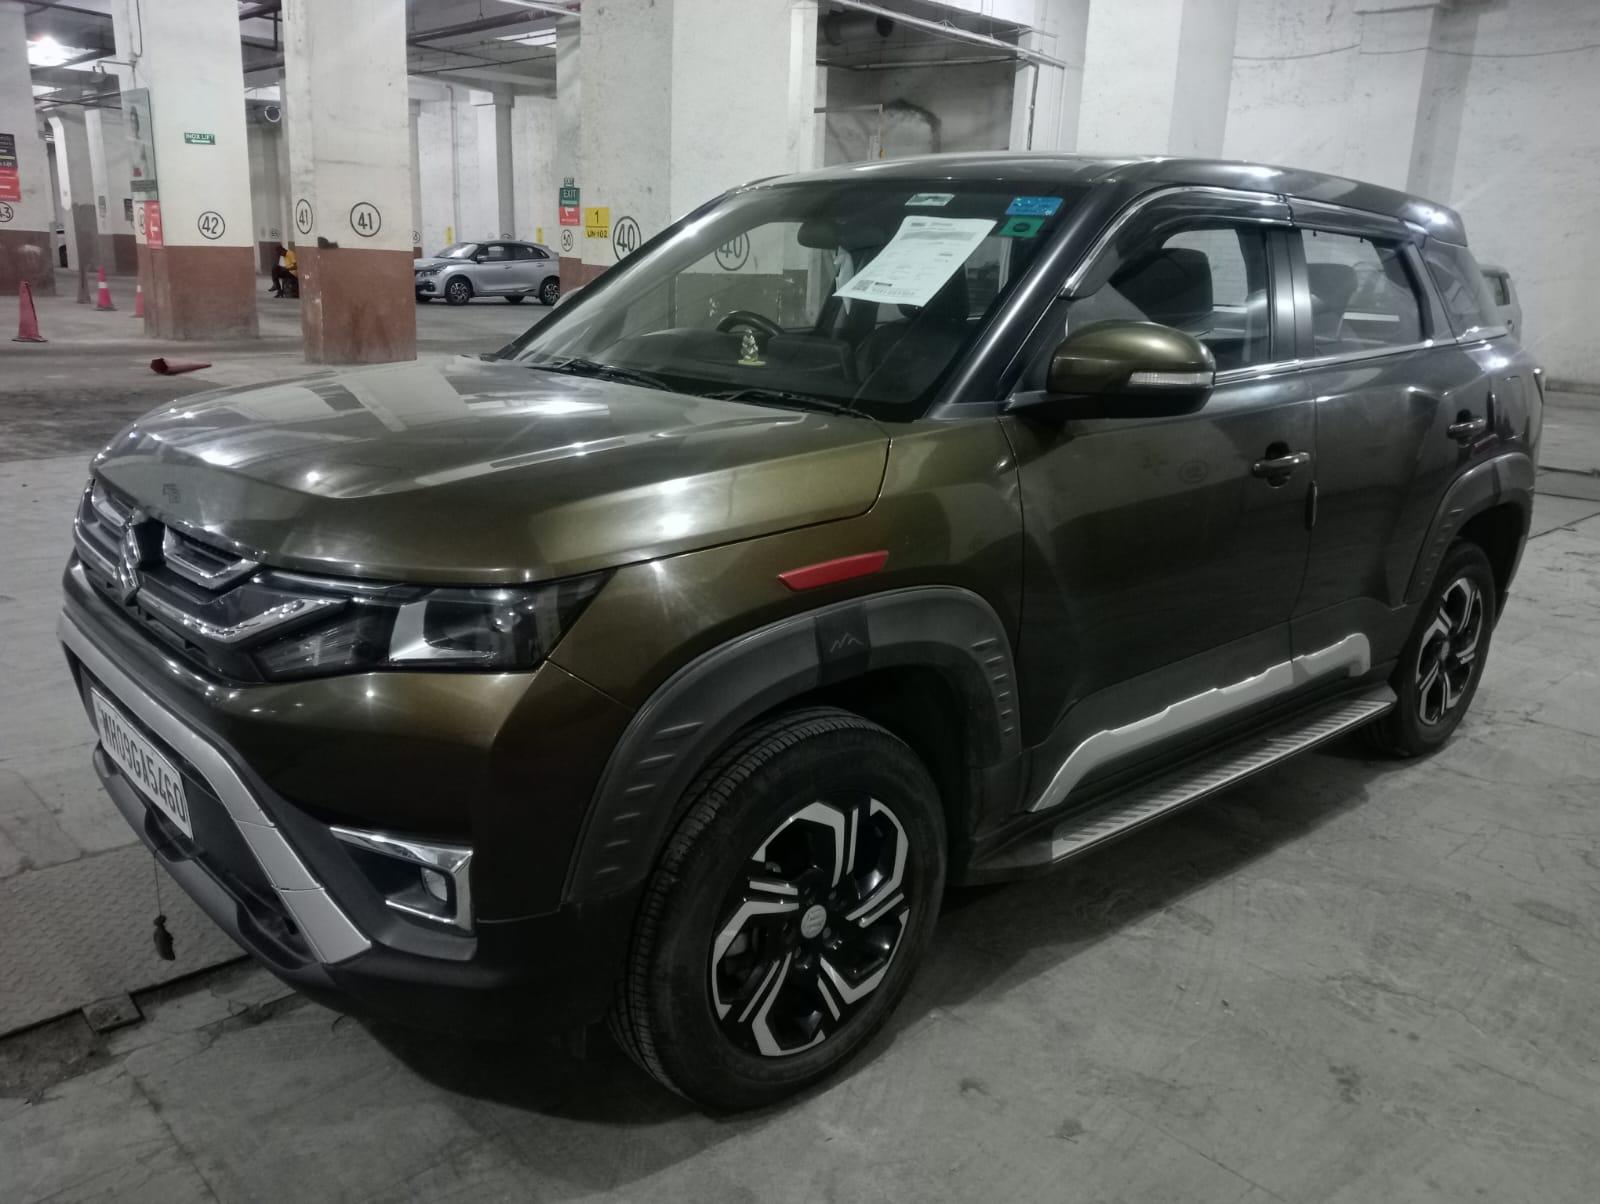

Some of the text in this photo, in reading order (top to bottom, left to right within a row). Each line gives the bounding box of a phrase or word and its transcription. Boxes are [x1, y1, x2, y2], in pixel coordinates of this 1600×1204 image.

[563, 189, 576, 198] EXIT
[202, 215, 219, 234] 42
[299, 209, 309, 226] 41
[358, 212, 373, 231] 41
[594, 209, 599, 224] 1
[617, 223, 635, 252] 40
